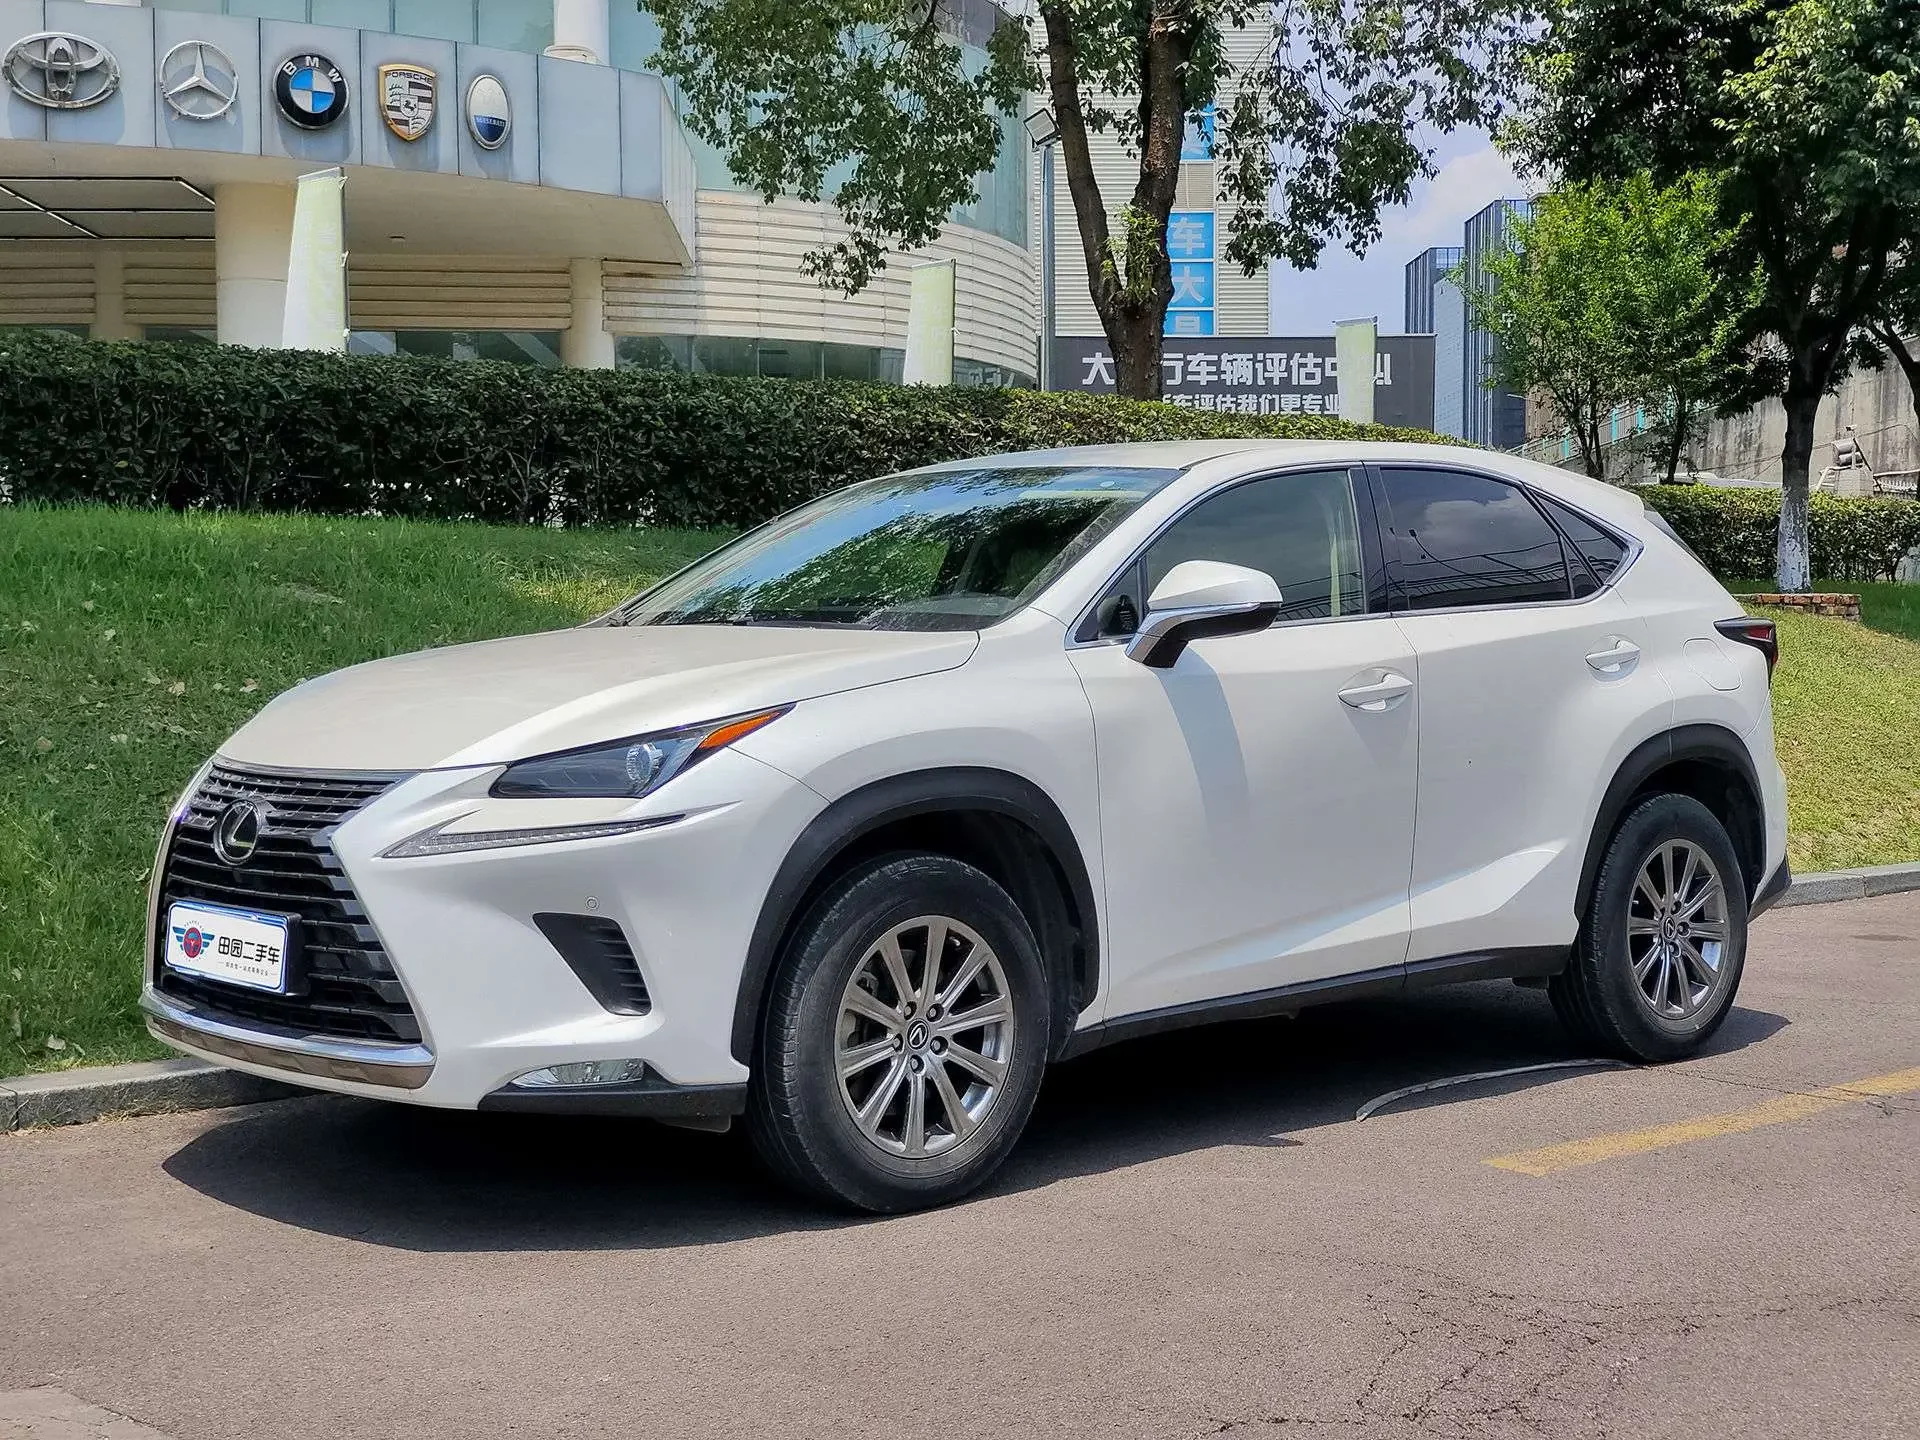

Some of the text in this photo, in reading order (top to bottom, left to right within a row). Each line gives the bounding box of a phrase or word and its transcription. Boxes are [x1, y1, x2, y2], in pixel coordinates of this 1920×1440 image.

[283, 56, 342, 83] BMW
[385, 71, 433, 84] PORSCHE
[1162, 394, 1340, 415] 车评估我们更专业
[218, 936, 281, 965] 田园二手车
